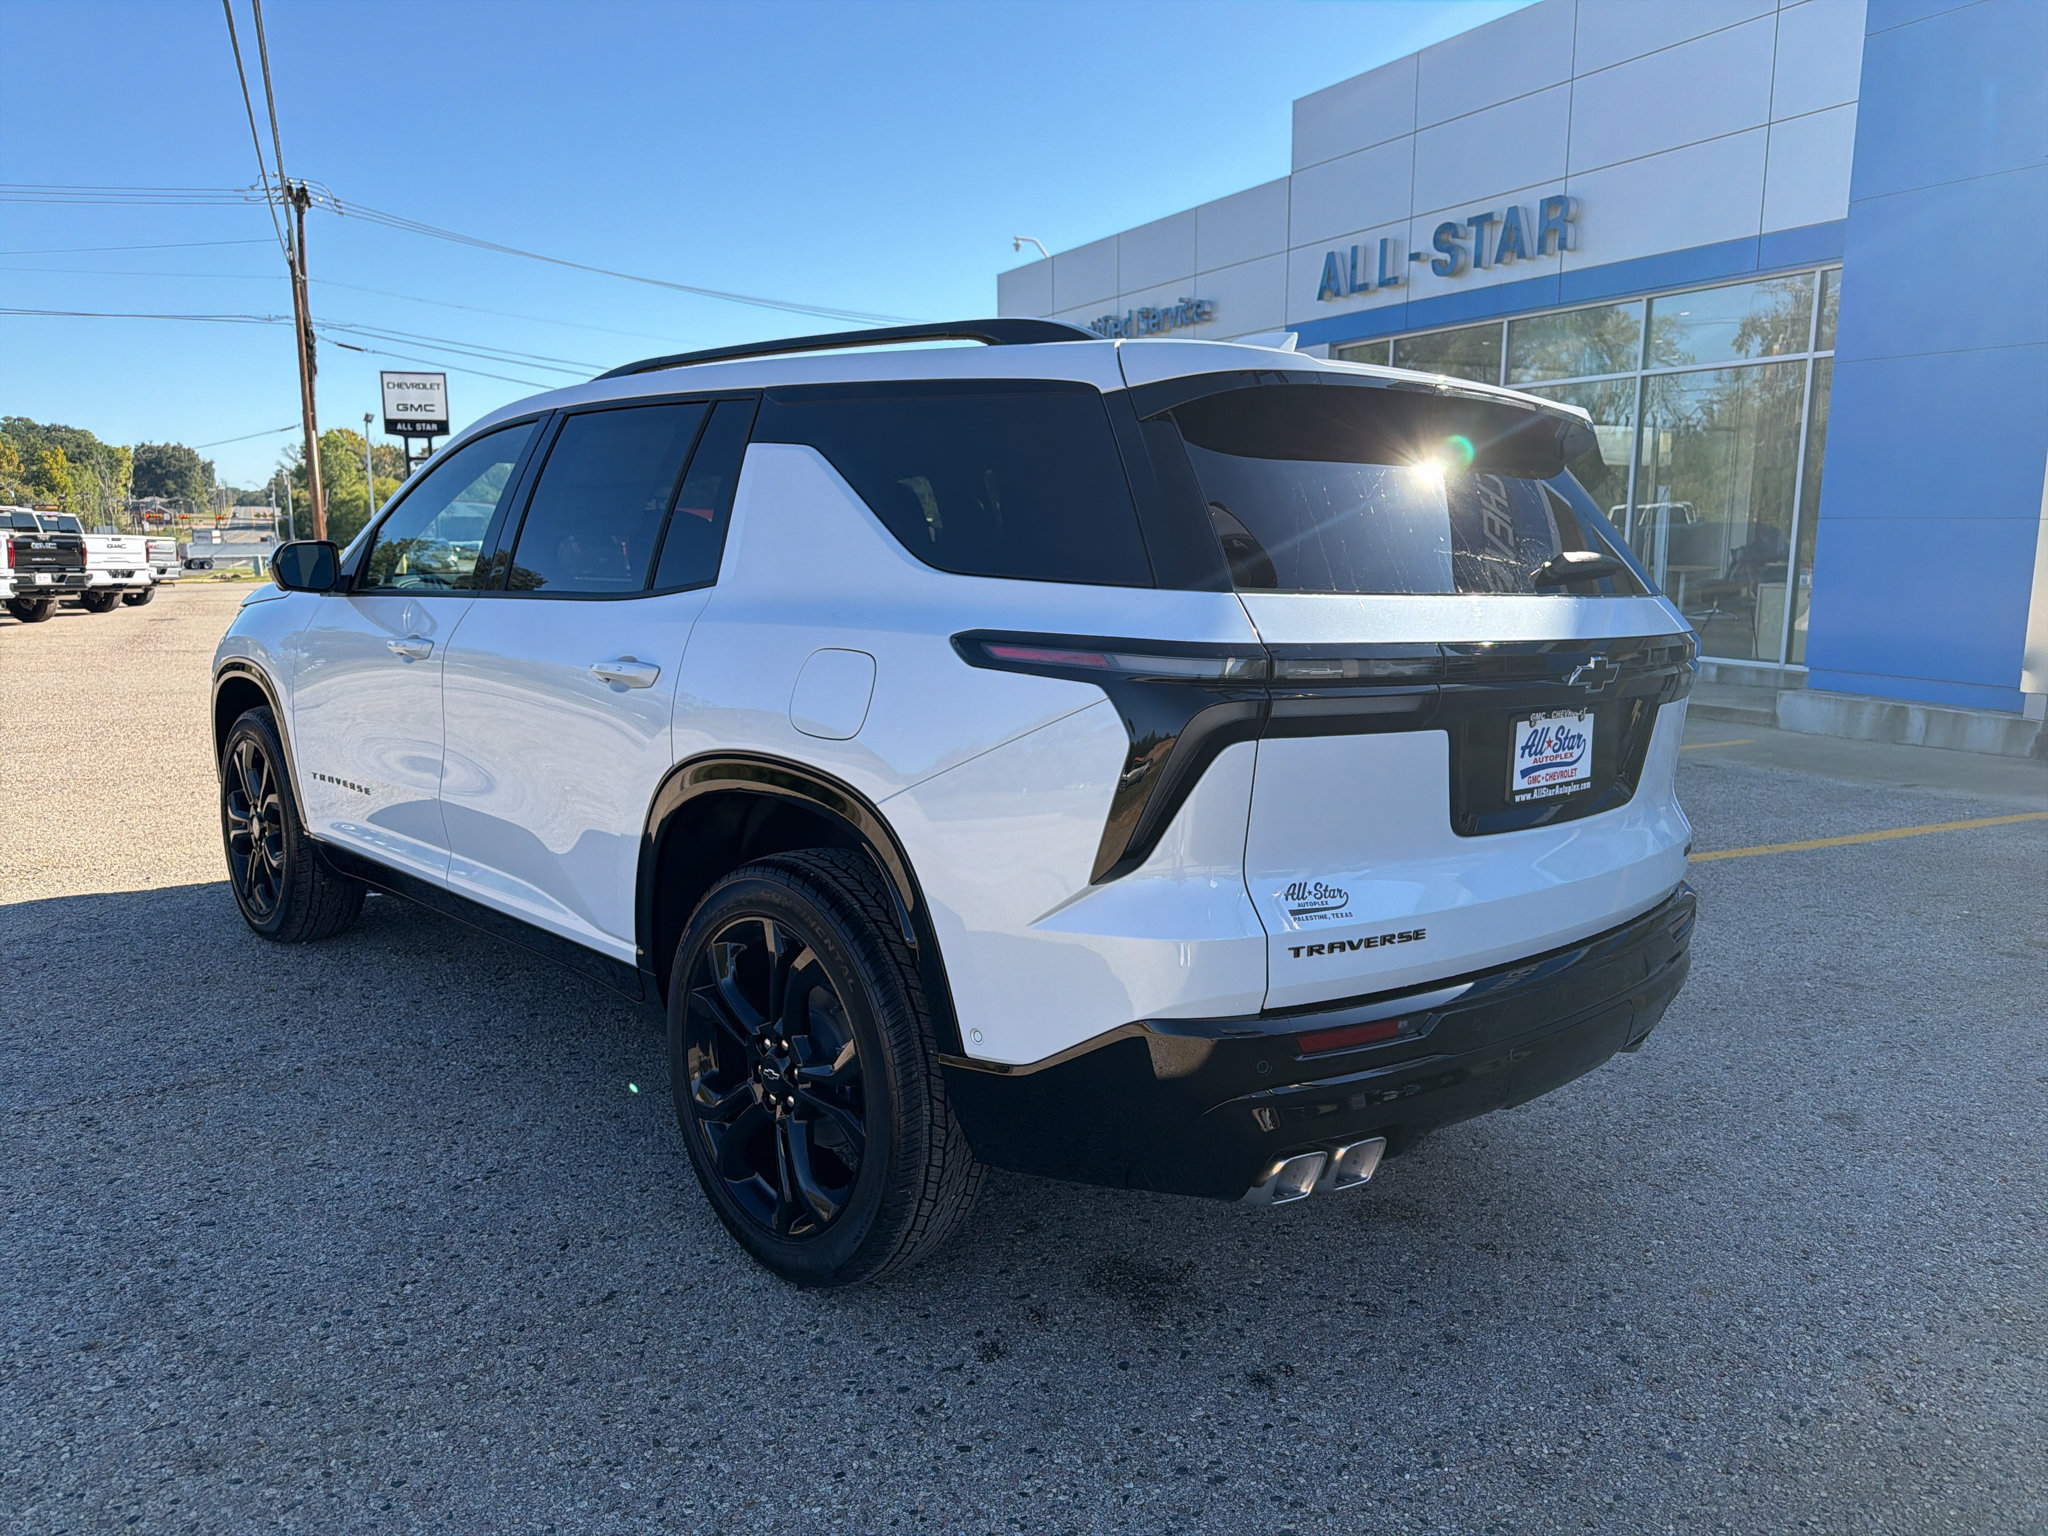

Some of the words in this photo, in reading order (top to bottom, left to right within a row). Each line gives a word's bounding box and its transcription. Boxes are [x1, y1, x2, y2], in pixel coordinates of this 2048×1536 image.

[1317, 194, 1579, 301] ALL-STAR
[1137, 297, 1210, 336] Service
[386, 381, 441, 391] CHEVROLET
[396, 403, 436, 413] GMC
[396, 422, 413, 431] ALL
[415, 422, 438, 432] STAR
[1520, 726, 1550, 759] All
[1552, 725, 1584, 753] Star
[1533, 752, 1574, 764] AUTOPLEX
[311, 772, 372, 795] TRAVERSE
[1515, 781, 1591, 803] www.AllStarAutoplex.com
[1284, 881, 1308, 902] All
[1313, 882, 1345, 900] Star
[1293, 914, 1331, 922] PALESTINE,
[1332, 911, 1354, 919] TEXAS
[1288, 928, 1427, 959] TRAVERSE
